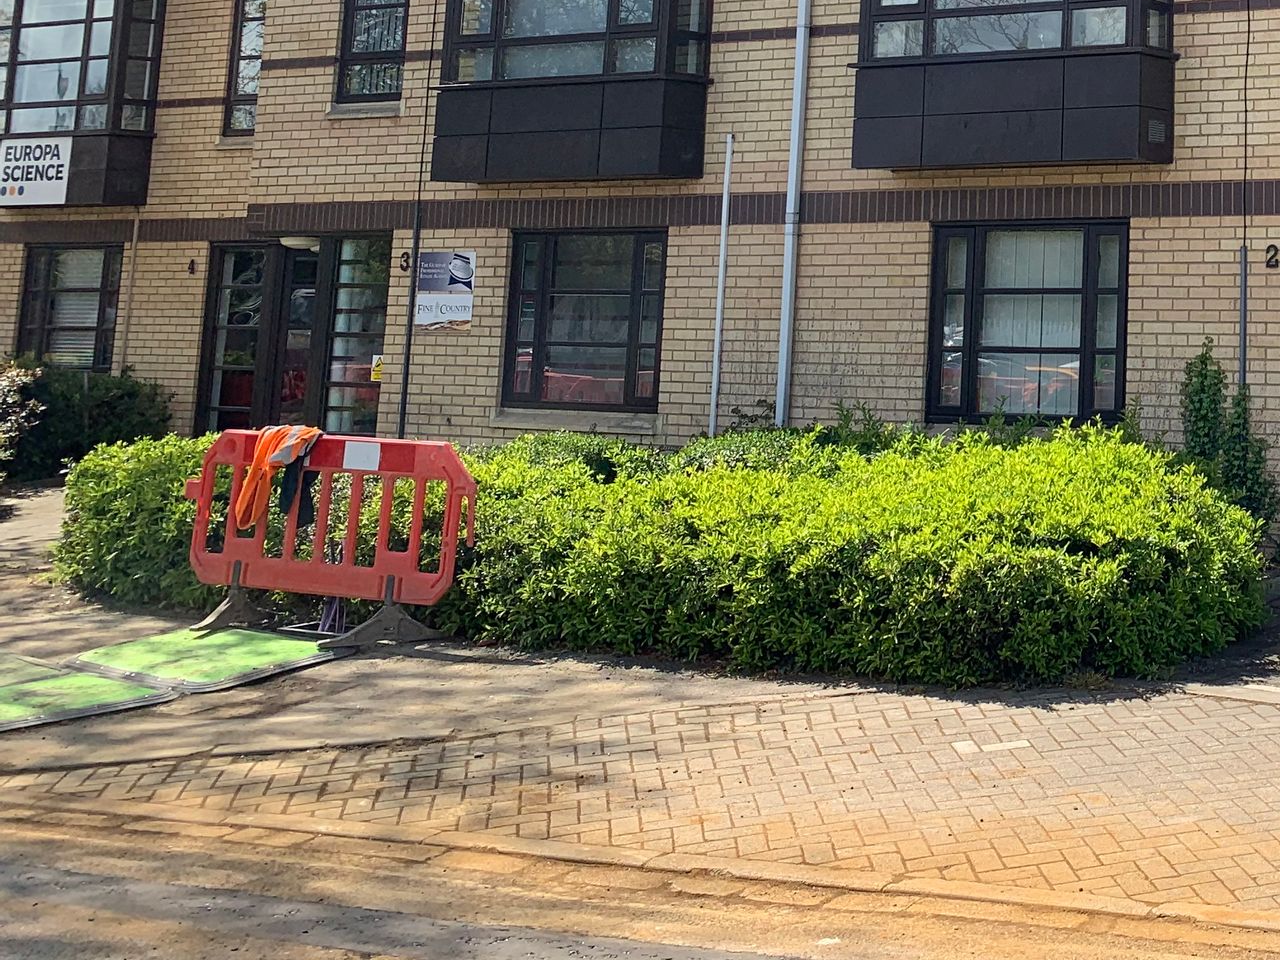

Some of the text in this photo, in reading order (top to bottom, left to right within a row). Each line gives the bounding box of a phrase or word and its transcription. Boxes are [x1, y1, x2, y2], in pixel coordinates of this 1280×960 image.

[4, 144, 61, 162] EUROPA
[1, 164, 65, 182] SCIENCE
[400, 252, 410, 272] 3
[1266, 244, 1279, 268] 2
[188, 258, 195, 275] 4
[417, 304, 471, 315] FINE COUNTRY
